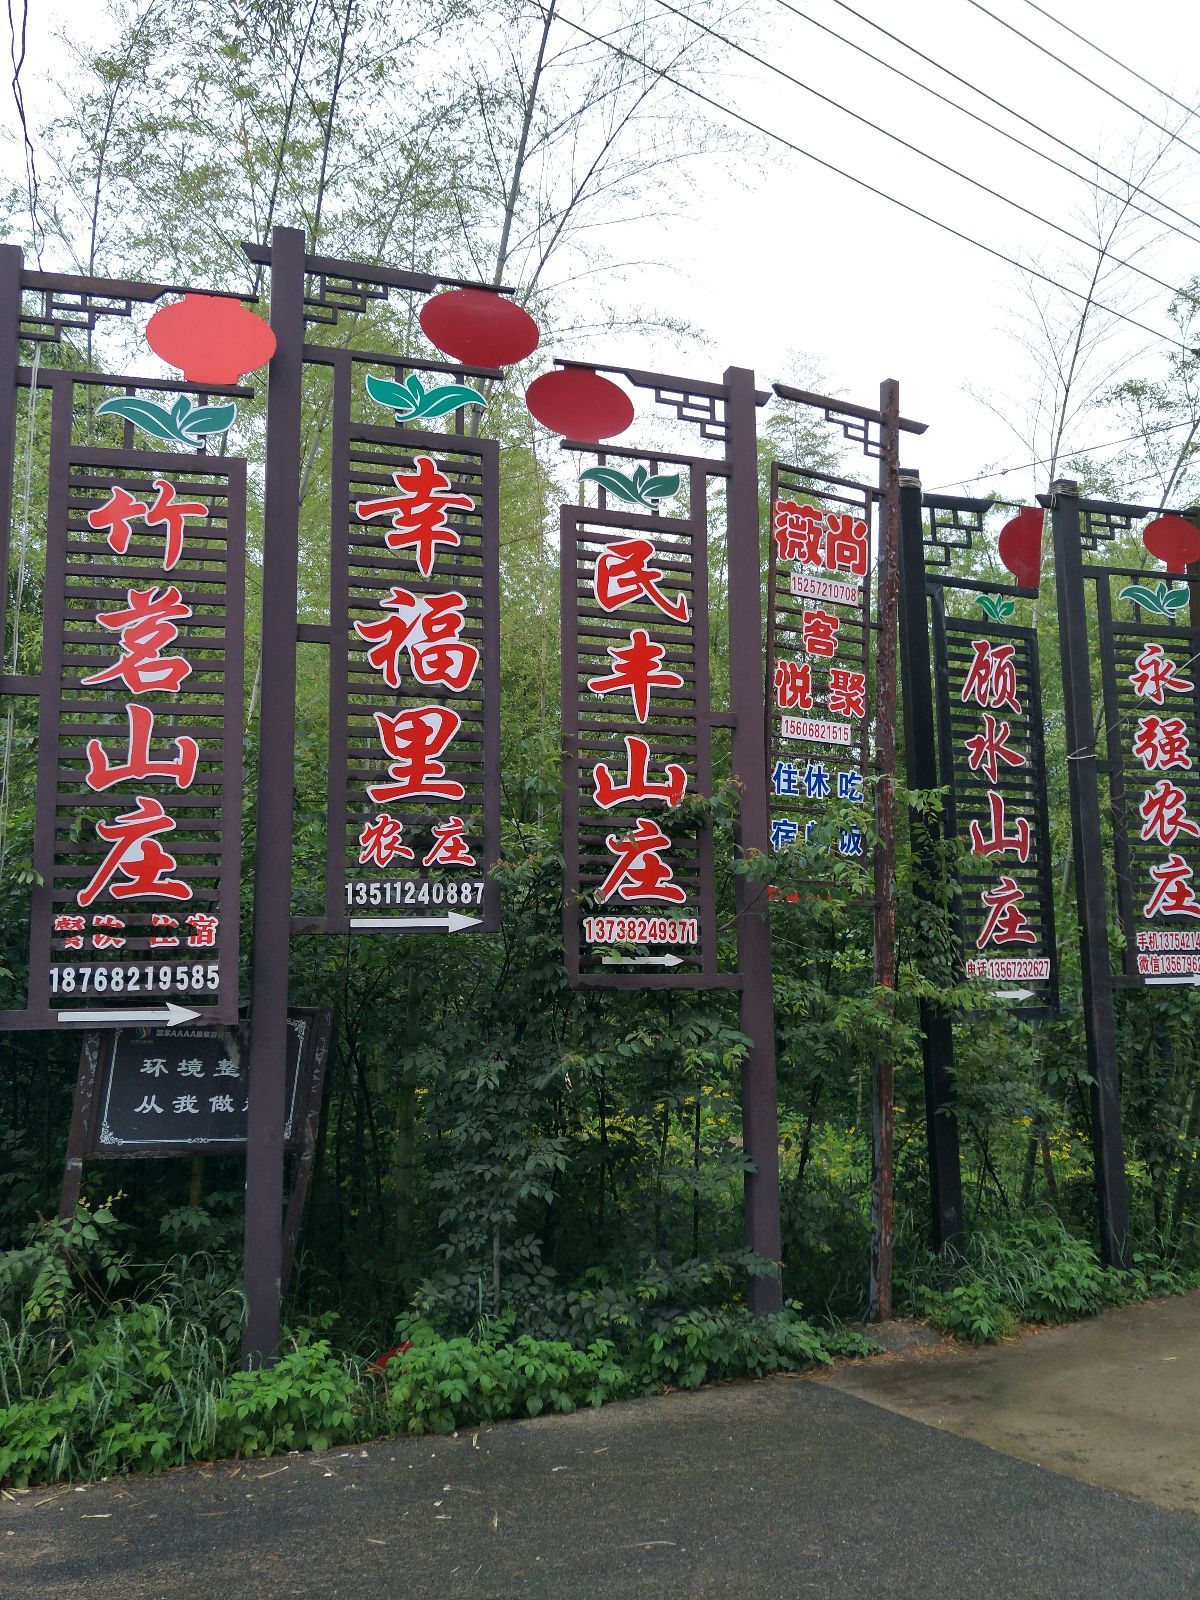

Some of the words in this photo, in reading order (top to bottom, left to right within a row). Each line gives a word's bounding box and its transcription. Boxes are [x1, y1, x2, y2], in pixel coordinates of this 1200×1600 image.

[791, 576, 858, 602] 15257210708
[354, 455, 480, 803] 幸福里
[802, 610, 839, 657] 客
[77, 479, 209, 906] 竹茗山庄
[587, 539, 690, 904] 民丰山庄
[784, 719, 849, 742] 15606821515
[962, 640, 1037, 949] 顾水山庄
[1129, 643, 1200, 918] 永强农庄
[359, 813, 477, 868] 农庄
[344, 881, 485, 905] 13511240887
[583, 916, 698, 943] 13738249371
[49, 965, 220, 993] 18768219585
[140, 1058, 249, 1078] 环境整
[134, 1094, 249, 1113] 从我做
